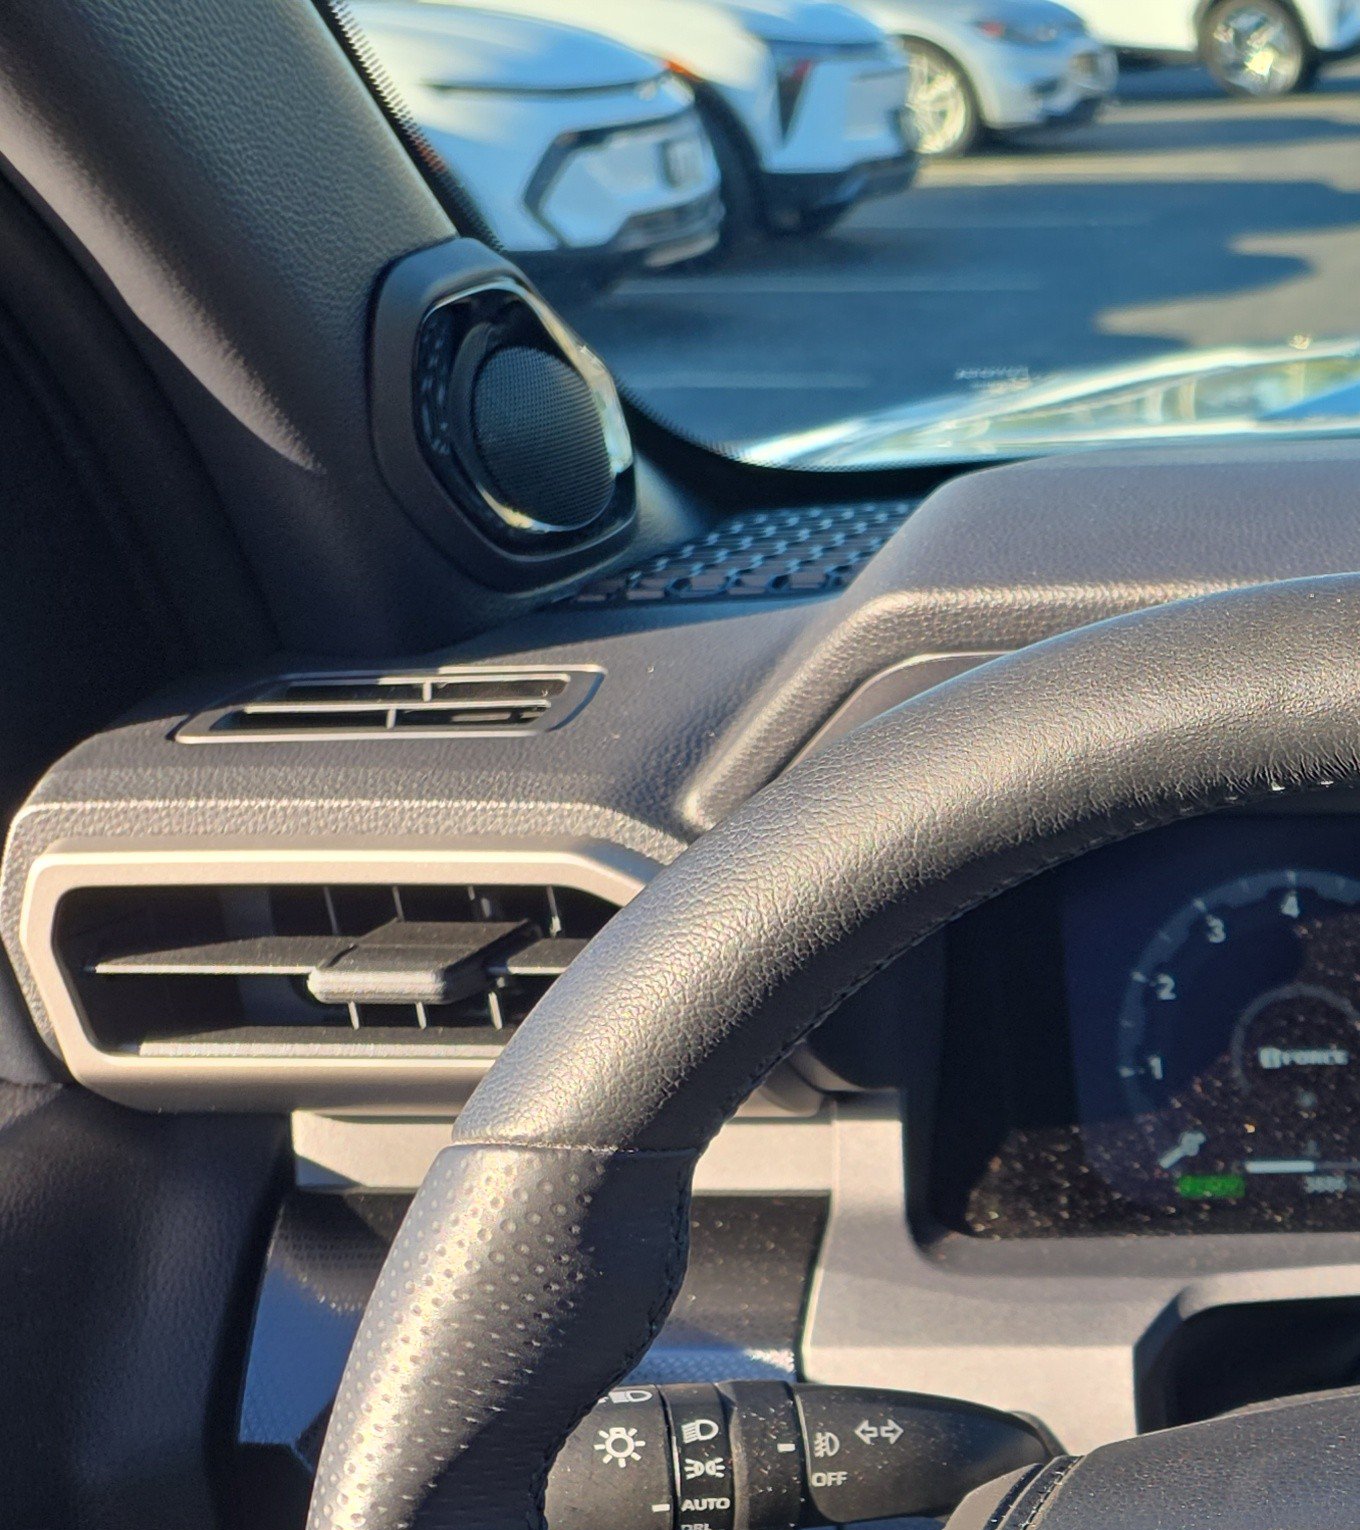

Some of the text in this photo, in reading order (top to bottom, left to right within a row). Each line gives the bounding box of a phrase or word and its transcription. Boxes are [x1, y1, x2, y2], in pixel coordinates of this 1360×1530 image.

[1281, 894, 1299, 918] 4
[1205, 918, 1225, 943] 3
[1156, 975, 1176, 999] 2
[1149, 1056, 1162, 1079] 1
[812, 1471, 847, 1487] OFF
[682, 1498, 730, 1511] AUTO
